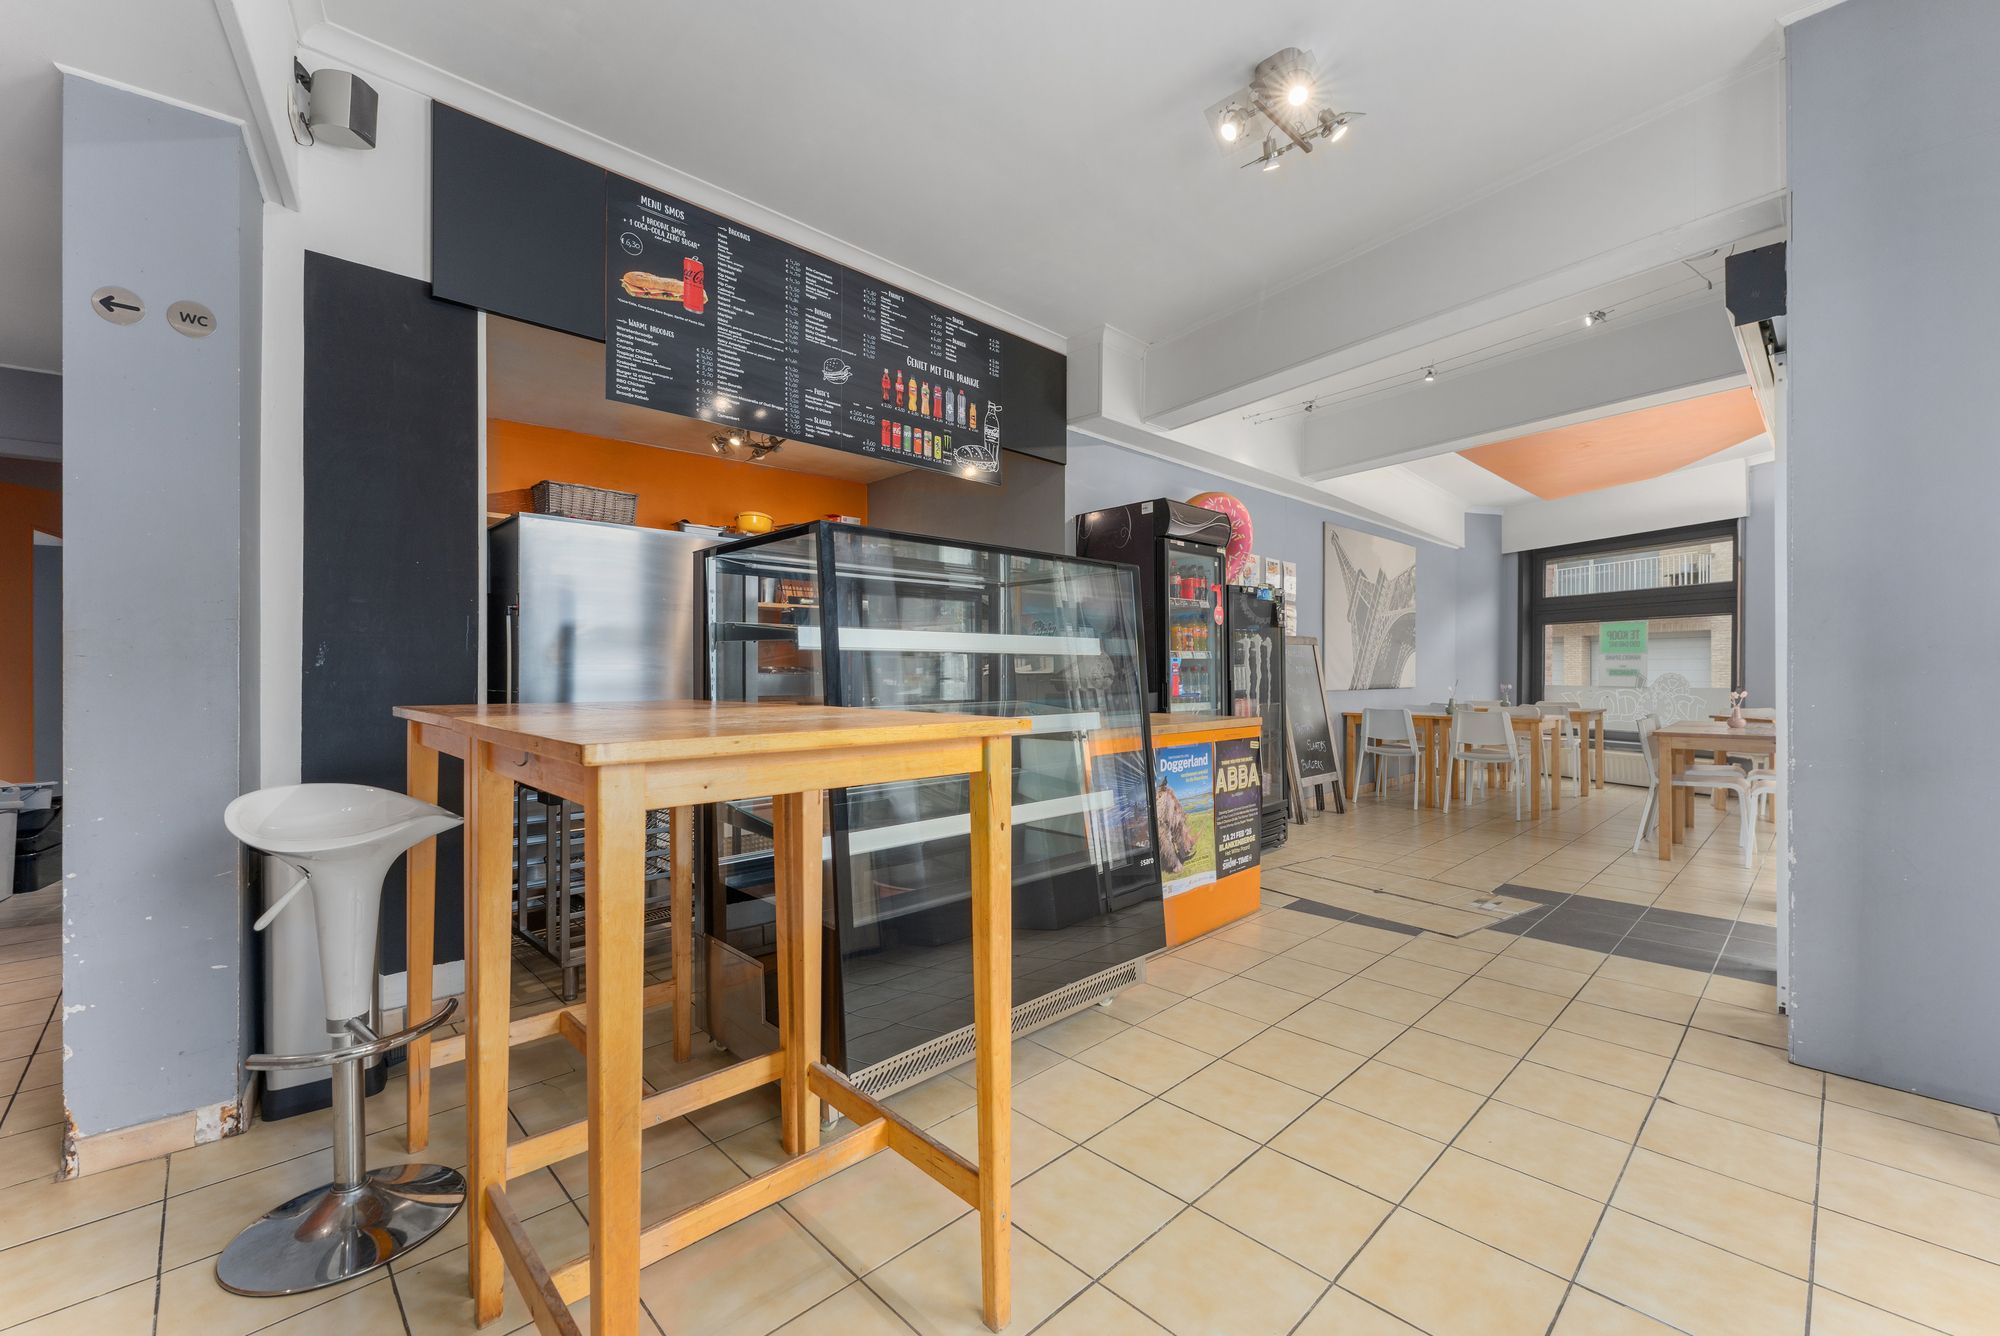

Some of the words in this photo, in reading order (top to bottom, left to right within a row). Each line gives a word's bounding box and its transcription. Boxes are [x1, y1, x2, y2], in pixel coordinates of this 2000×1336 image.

[640, 194, 662, 212] MENU
[664, 204, 685, 221] SMOS
[634, 219, 665, 238] COCA-COLA
[666, 231, 680, 243] ZERO
[647, 216, 670, 232] BROODJE
[671, 225, 686, 238] SMOS
[625, 237, 640, 251] 6,30
[180, 311, 208, 327] WC
[628, 318, 647, 331] WARME
[649, 324, 674, 338] BROODJES
[906, 354, 927, 372] GENIET
[930, 363, 942, 377] MET
[943, 368, 954, 381] EEN
[956, 372, 980, 389] DRANKJE
[1160, 752, 1208, 773] Doggerland
[1215, 762, 1260, 794] ABBA
[1219, 834, 1256, 852] BLANKENBERGE
